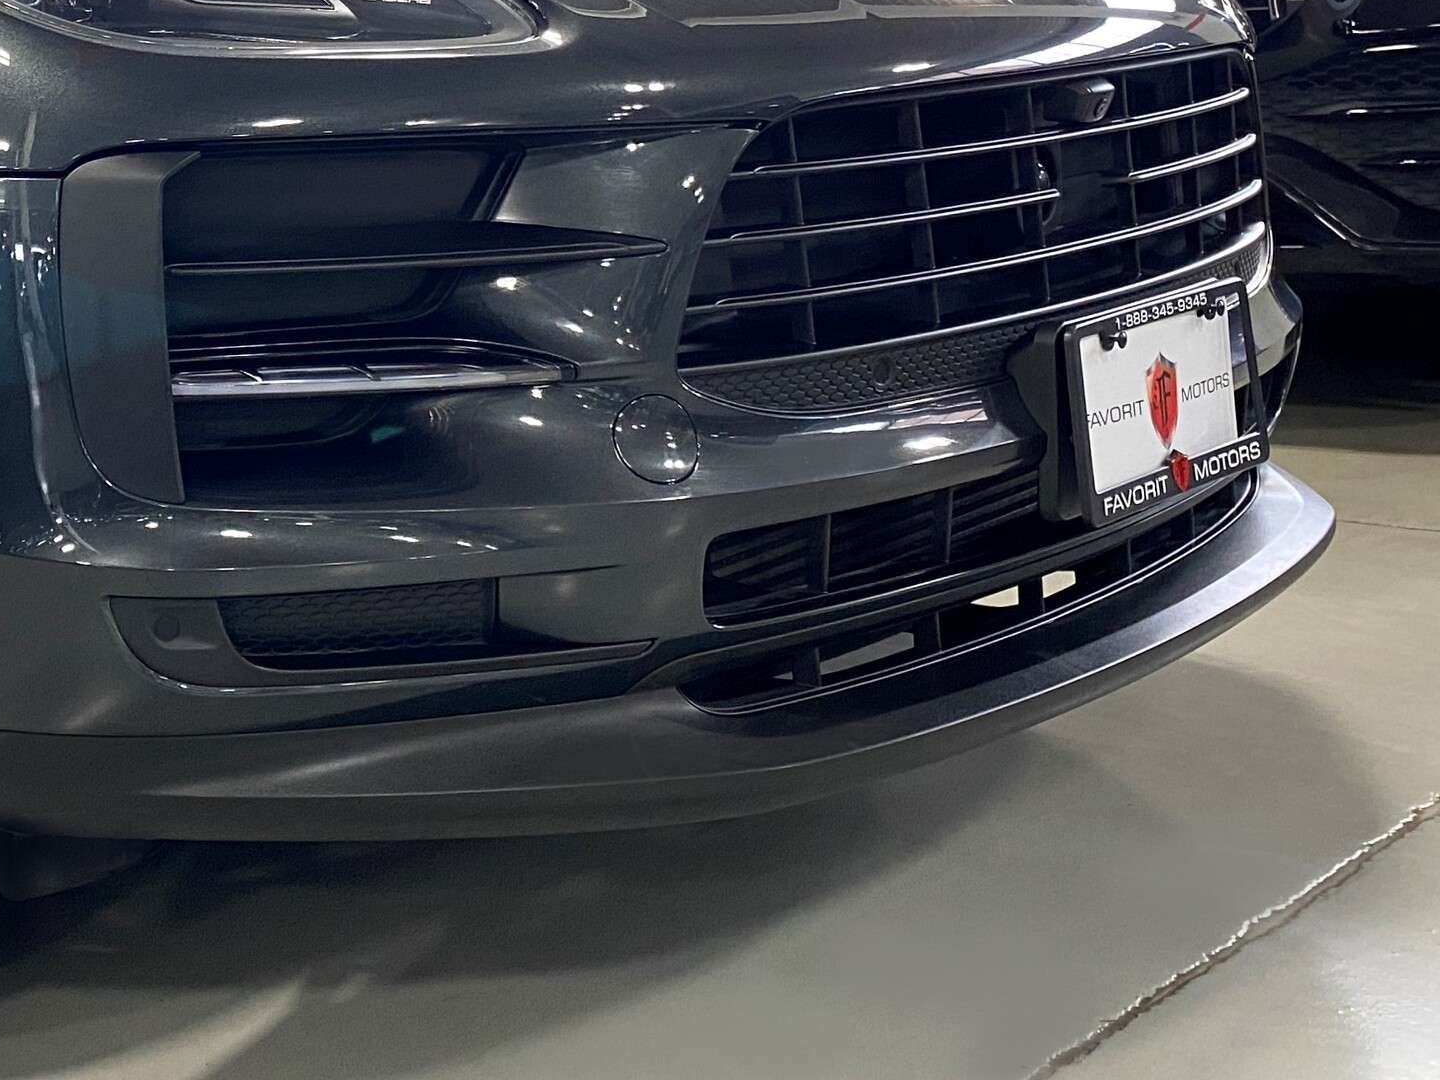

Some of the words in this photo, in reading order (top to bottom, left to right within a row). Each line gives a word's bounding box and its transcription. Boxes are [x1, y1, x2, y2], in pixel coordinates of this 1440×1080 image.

[1116, 293, 1207, 330] 1-888-345-9345
[1181, 372, 1230, 402] MOTORS
[1103, 475, 1169, 517] FAVORIT
[1193, 441, 1261, 482] MOTORS
